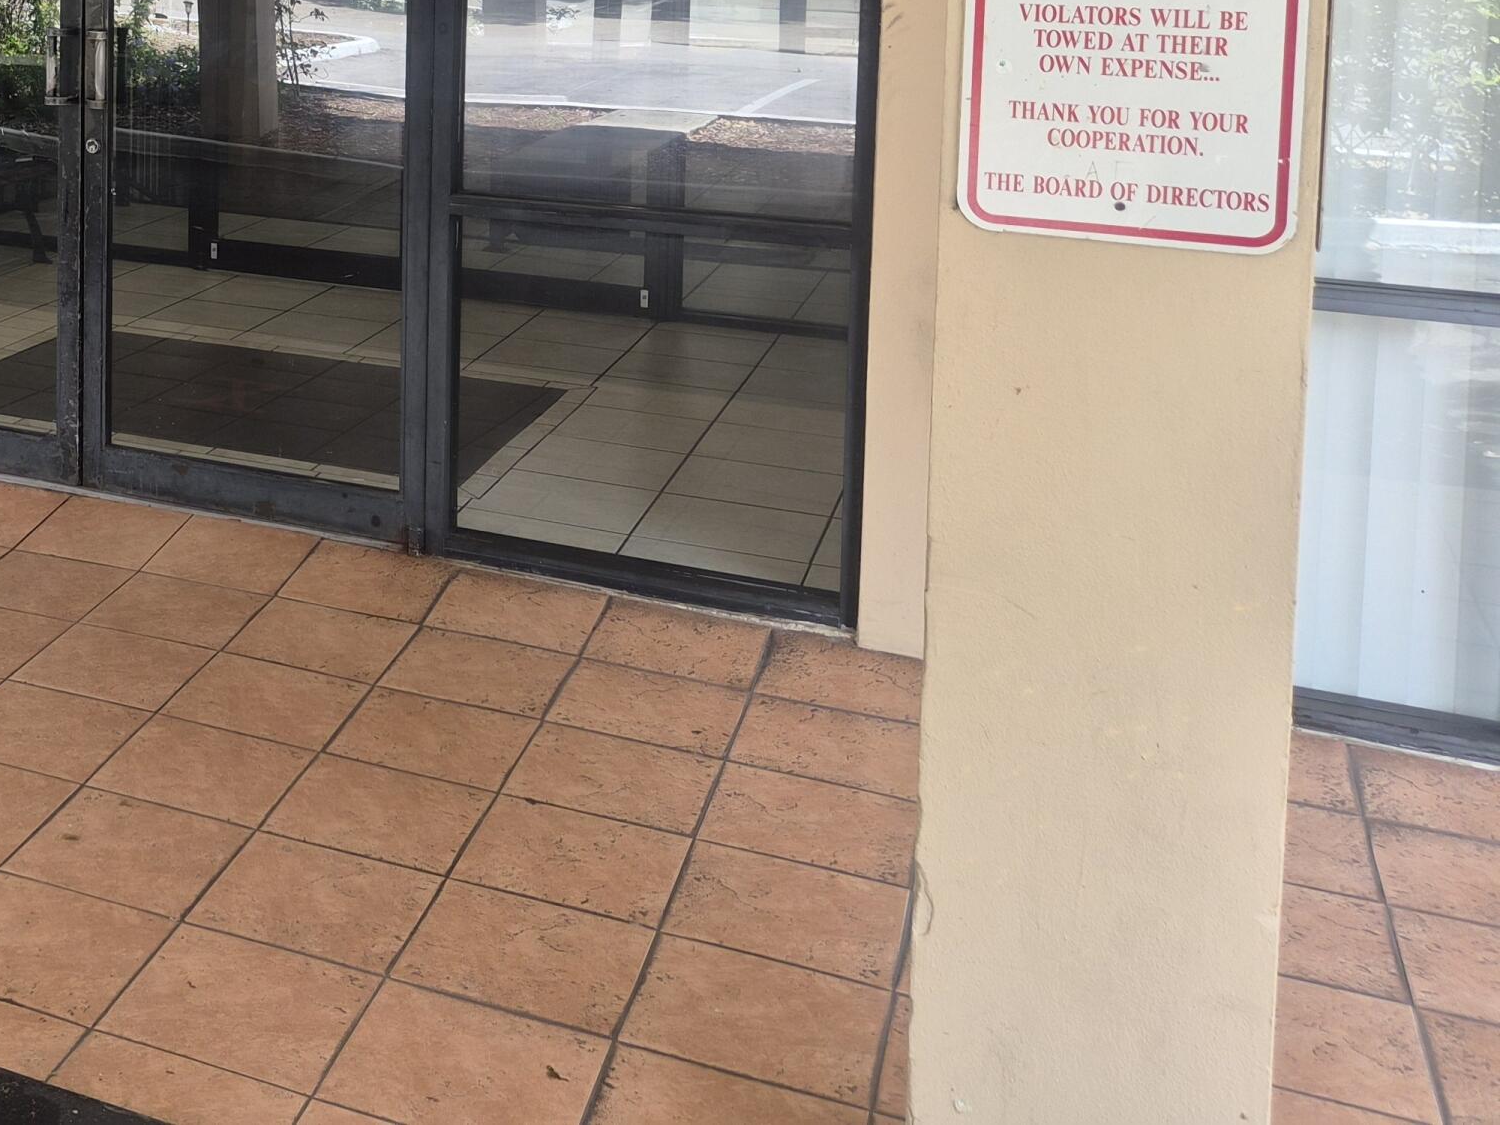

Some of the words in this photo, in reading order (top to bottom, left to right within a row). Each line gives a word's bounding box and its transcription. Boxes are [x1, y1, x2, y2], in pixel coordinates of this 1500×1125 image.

[1019, 4, 1142, 27] VIOLATORS
[1151, 9, 1210, 30] WILL
[1219, 10, 1249, 31] BE
[1034, 29, 1113, 51] TOWED
[1120, 33, 1149, 53] AT
[1156, 34, 1229, 57] THEIR
[1039, 55, 1091, 75] OWN
[1101, 58, 1221, 83] EXPENSE...
[1008, 101, 1080, 124] THANK
[1087, 106, 1130, 127] YOU
[1139, 109, 1181, 130] FOR
[1190, 113, 1249, 134] YOUR
[1047, 128, 1204, 157] COOPERATION.
[984, 172, 1025, 193] THE
[1033, 177, 1103, 200] BOARD
[1110, 181, 1139, 203] OF
[1147, 186, 1271, 214] DIRECTORS
